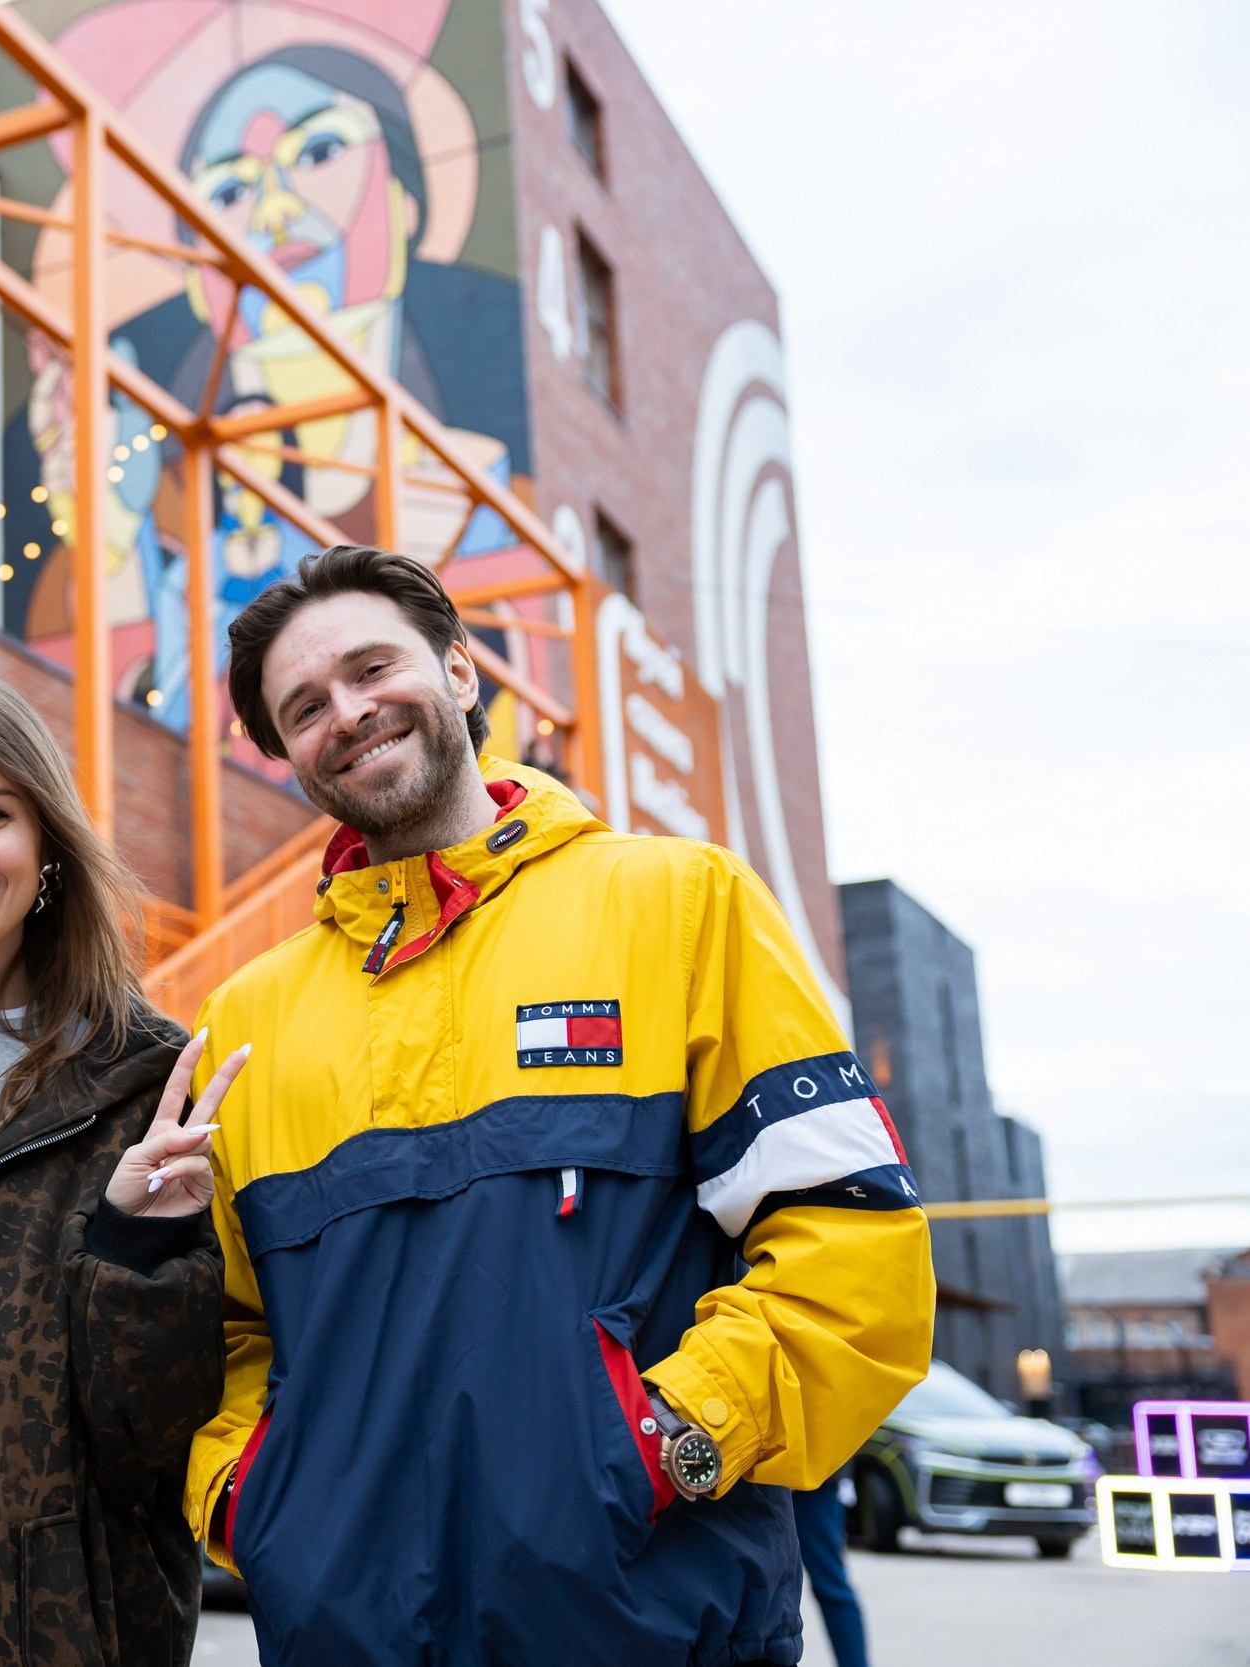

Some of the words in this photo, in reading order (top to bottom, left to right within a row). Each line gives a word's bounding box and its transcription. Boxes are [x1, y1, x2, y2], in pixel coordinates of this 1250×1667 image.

[519, 0, 556, 110] 5
[522, 1003, 611, 1018] TOMMY
[524, 1050, 615, 1064] JEANS
